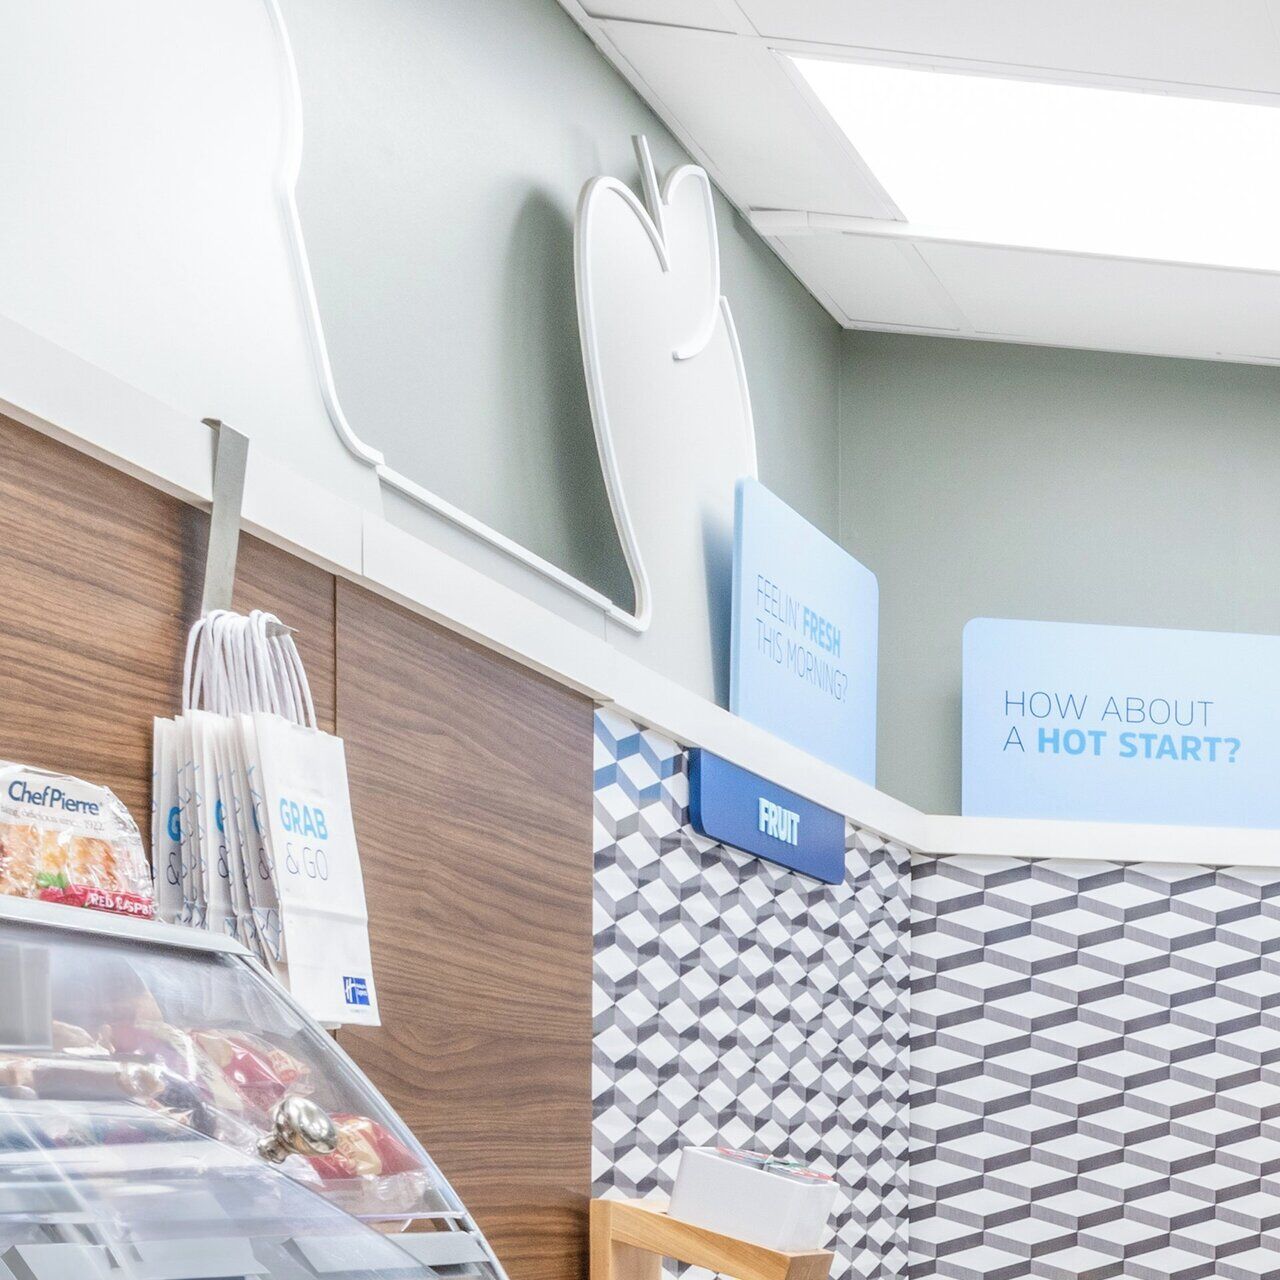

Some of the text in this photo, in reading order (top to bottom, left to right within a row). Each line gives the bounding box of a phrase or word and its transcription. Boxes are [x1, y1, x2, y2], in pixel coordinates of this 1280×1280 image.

[757, 574, 841, 658] FEELIN' FRESH
[756, 617, 848, 703] THIS MORNING?
[1005, 690, 1214, 727] HOW ABOUT
[1003, 726, 1242, 763] A HOT START?
[280, 798, 328, 840] GRAB
[758, 797, 800, 846] FRUIT
[303, 847, 329, 881] GO
